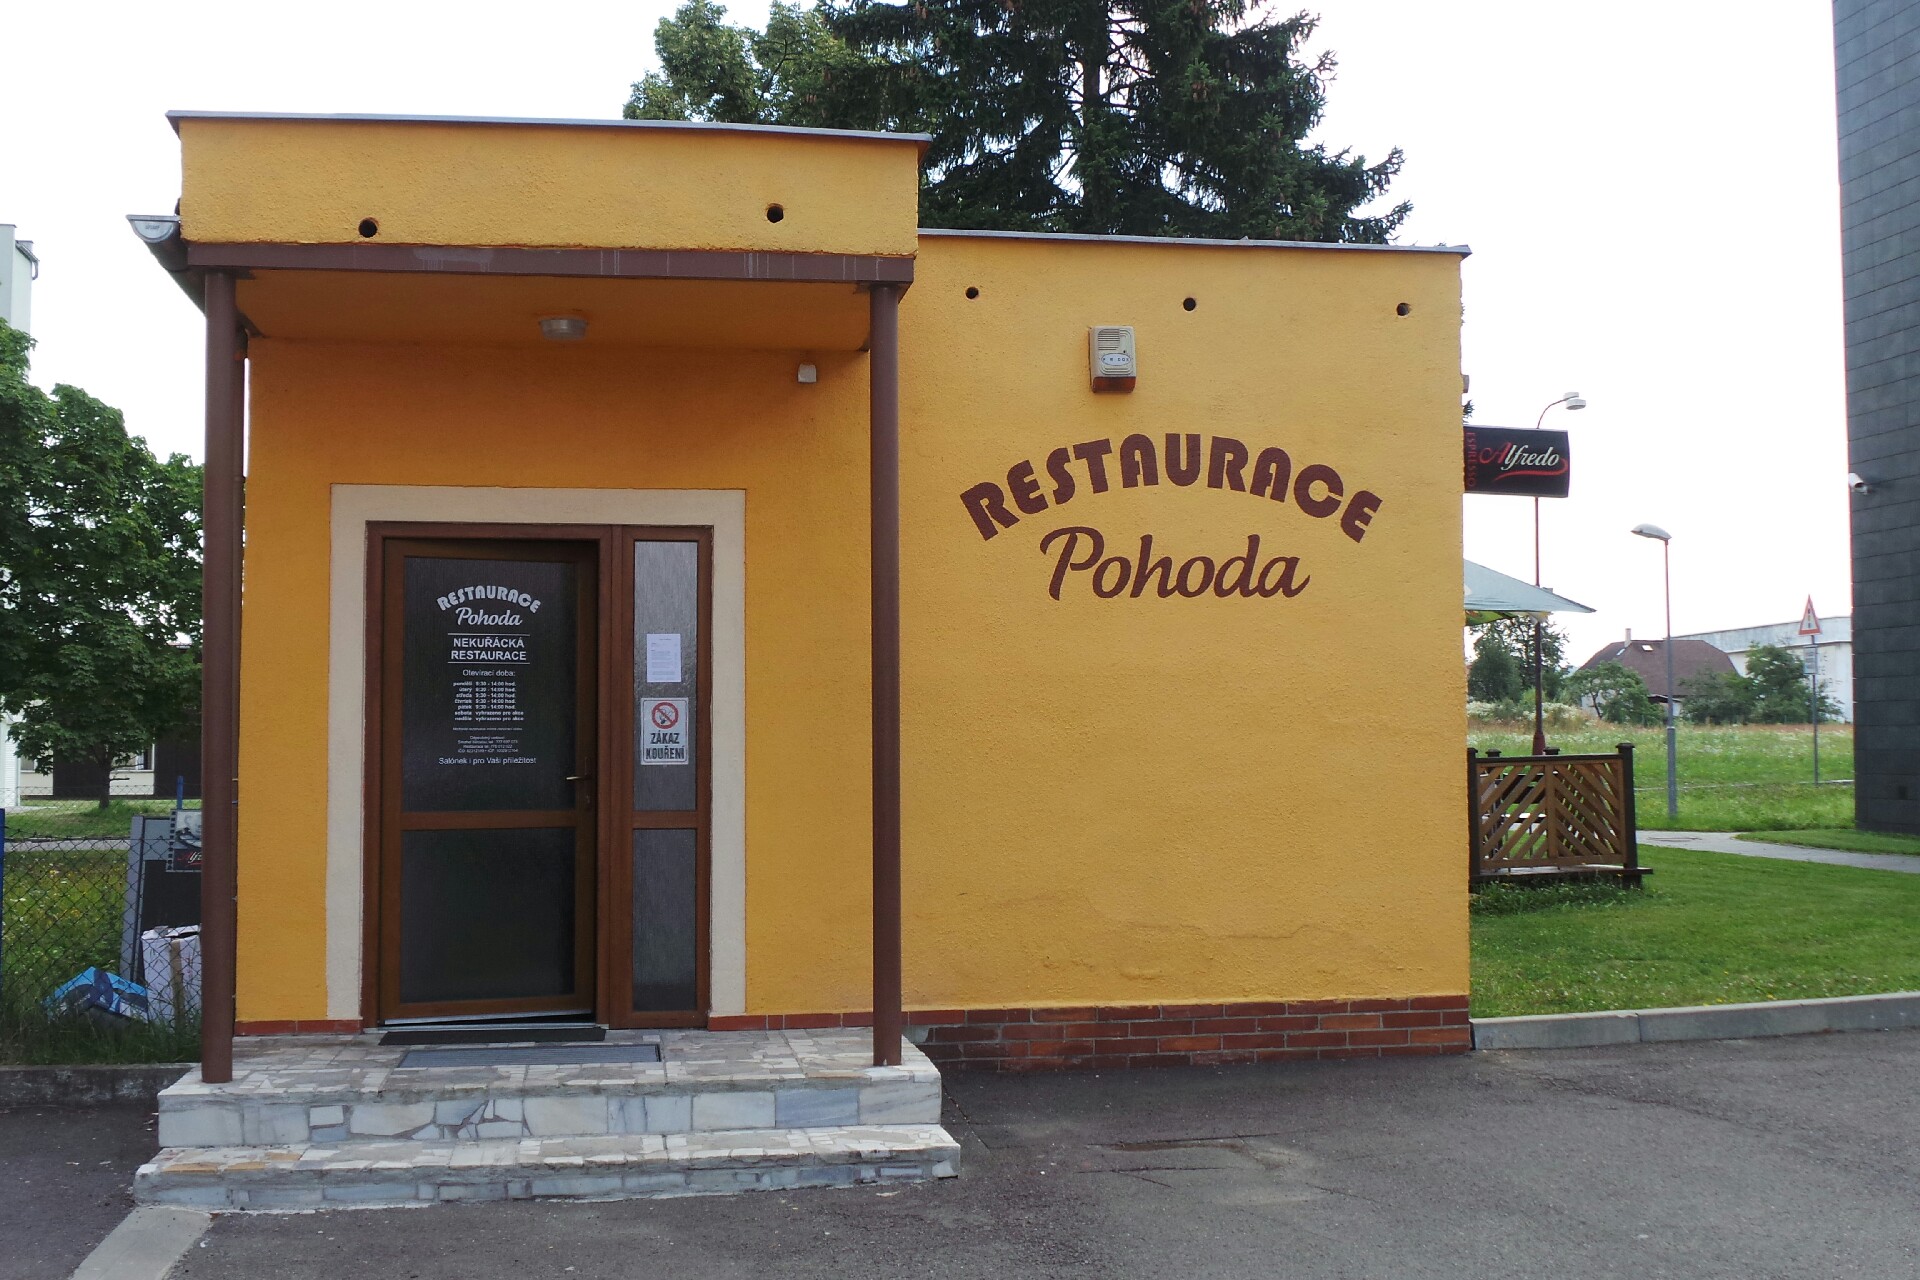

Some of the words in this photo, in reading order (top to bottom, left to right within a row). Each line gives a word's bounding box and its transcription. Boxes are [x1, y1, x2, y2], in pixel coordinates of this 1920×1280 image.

[1479, 441, 1560, 471] Alfredo
[960, 433, 1383, 543] RESTAURACE
[1040, 526, 1311, 601] Pohoda
[437, 585, 542, 613] RESTAURACE
[455, 606, 523, 626] Pohoda
[453, 636, 525, 648] NEKUŘÁCKÁ
[451, 650, 527, 660] RESTAURACE
[650, 730, 680, 744] ZÁKAZ
[645, 745, 685, 760] KOUŘENÍ
